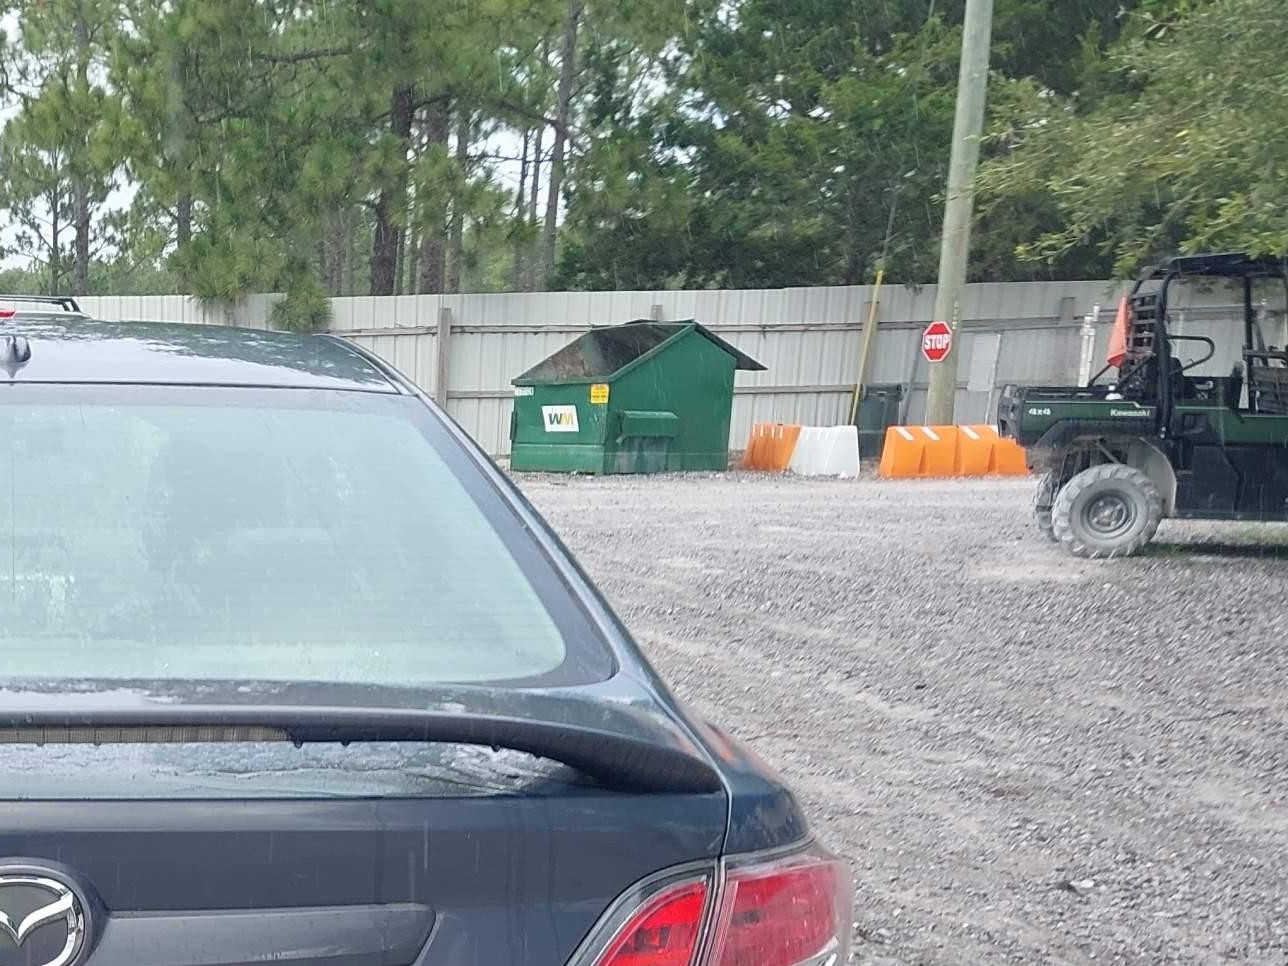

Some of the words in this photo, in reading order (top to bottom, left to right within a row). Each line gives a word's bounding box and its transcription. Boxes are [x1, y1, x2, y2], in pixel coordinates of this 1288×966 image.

[924, 333, 950, 350] STOP
[548, 412, 574, 425] WM
[1110, 408, 1150, 417] Kawasaki
